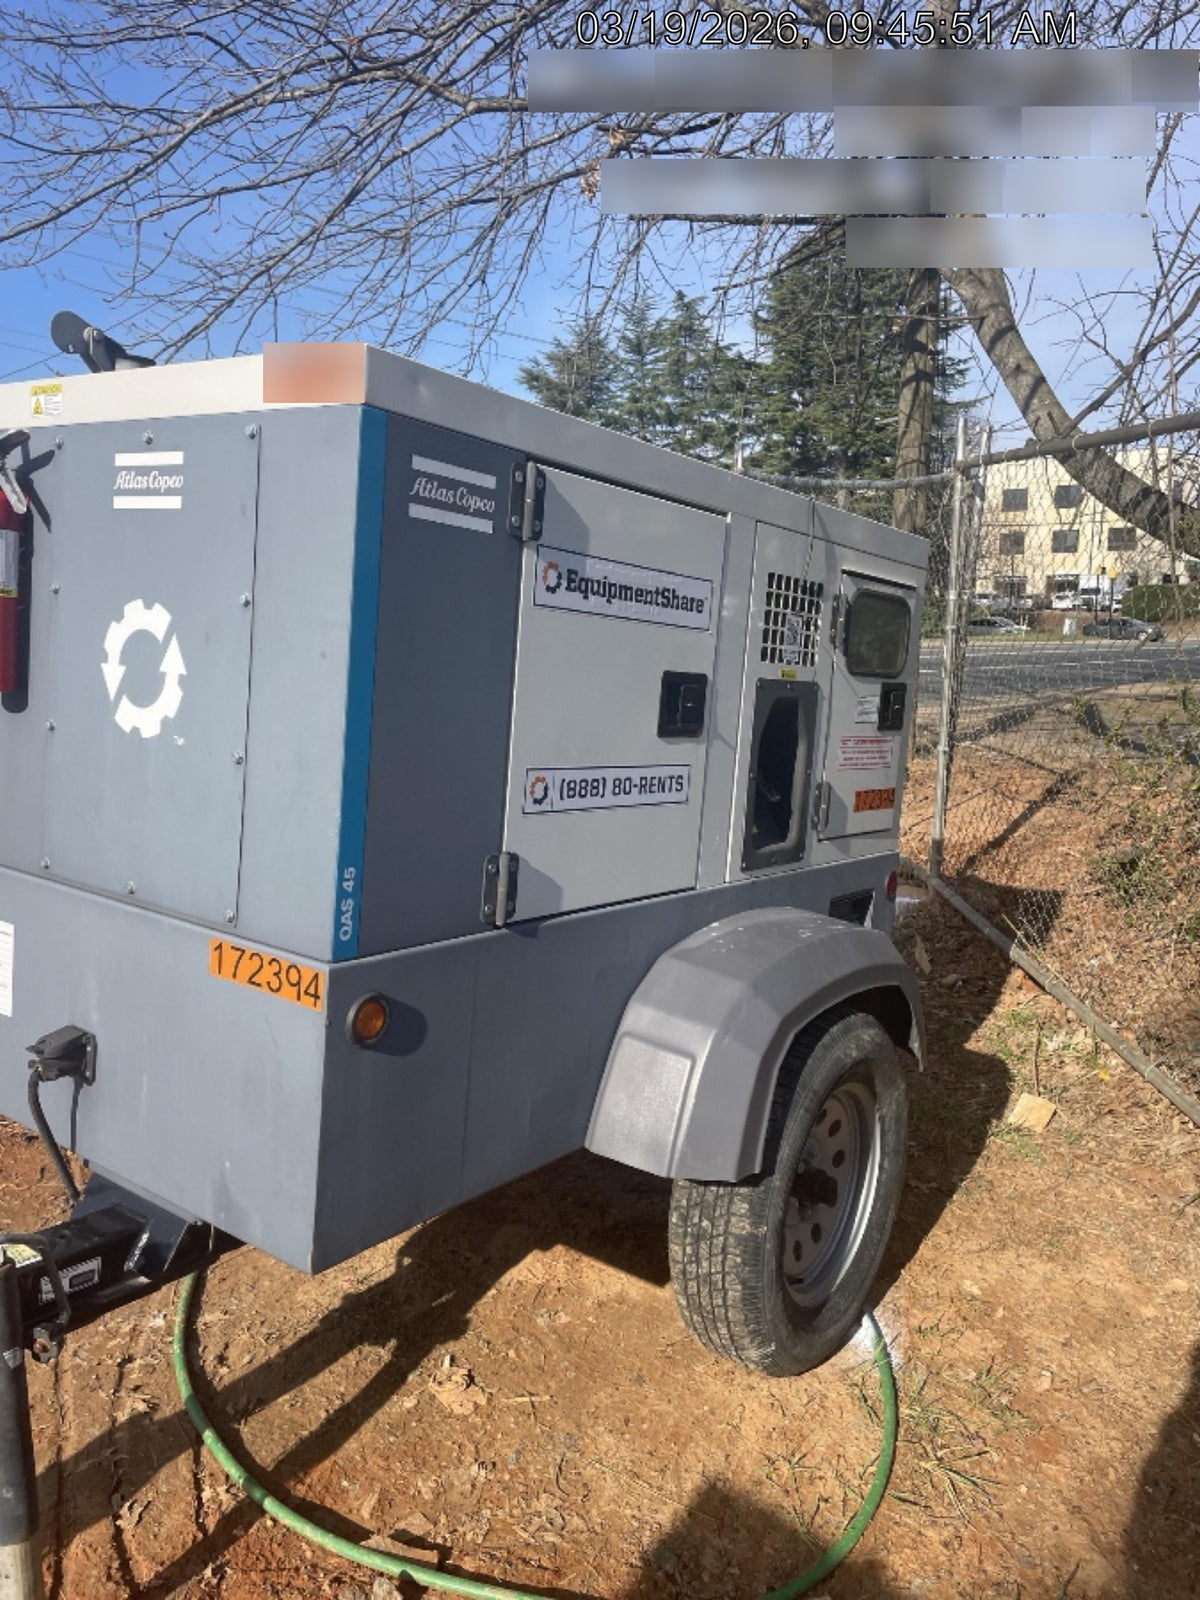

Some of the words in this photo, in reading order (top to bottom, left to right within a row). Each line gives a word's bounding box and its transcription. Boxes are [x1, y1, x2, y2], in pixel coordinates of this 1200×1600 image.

[113, 470, 148, 490] Atlas
[149, 470, 183, 493] Copco
[409, 477, 454, 503] Atlas
[456, 487, 495, 513] Copco
[565, 568, 705, 614] EquipmentShare
[559, 776, 607, 801] (888)
[612, 775, 684, 797] 80-RENTS
[342, 867, 356, 892] 45
[213, 941, 321, 1009] 172394
